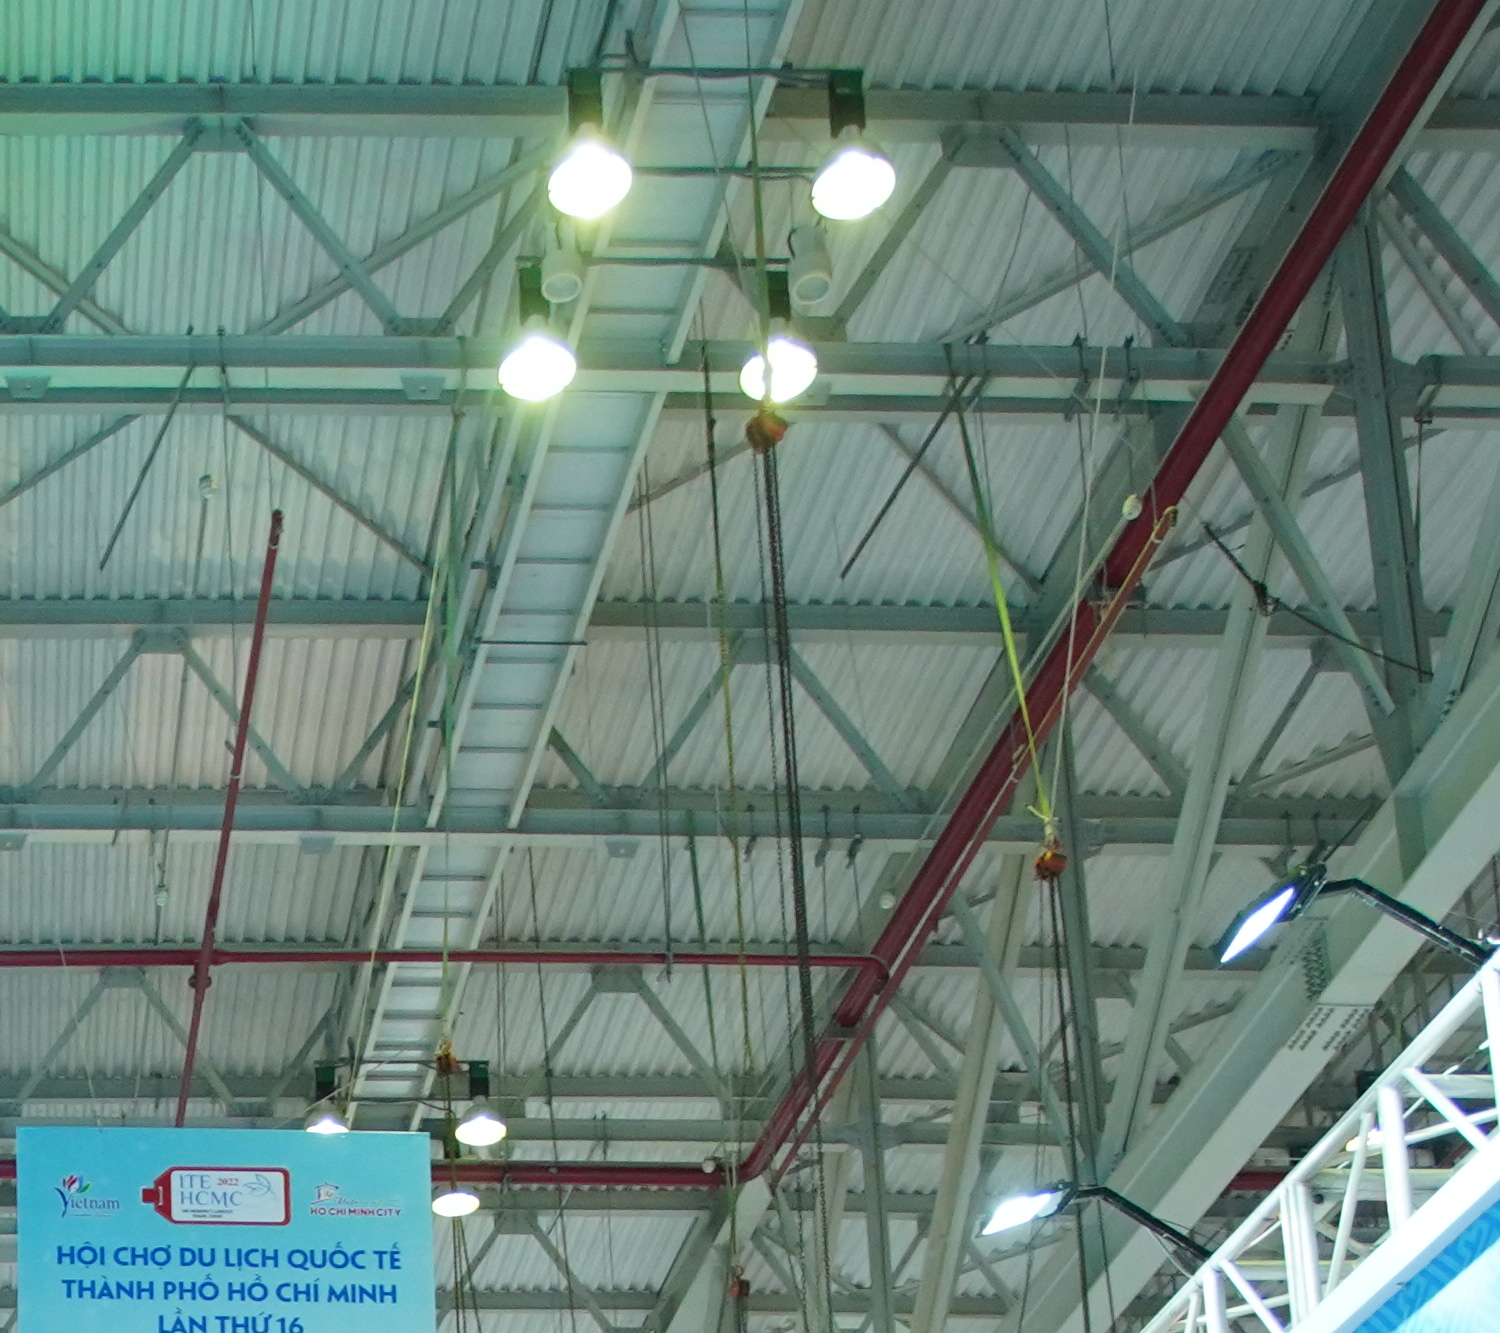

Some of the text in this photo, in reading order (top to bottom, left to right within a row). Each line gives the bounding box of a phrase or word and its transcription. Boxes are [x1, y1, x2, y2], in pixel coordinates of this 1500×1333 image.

[179, 1174, 239, 1189] ITE 2022
[180, 1190, 243, 1207] HCMC
[376, 1208, 401, 1217] CITY
[57, 1241, 402, 1272] HỘI CHỢ DU LỊCH QUỐC TẾ
[61, 1273, 397, 1304] THÀNH PHỐ HỒ CHÍ MINH
